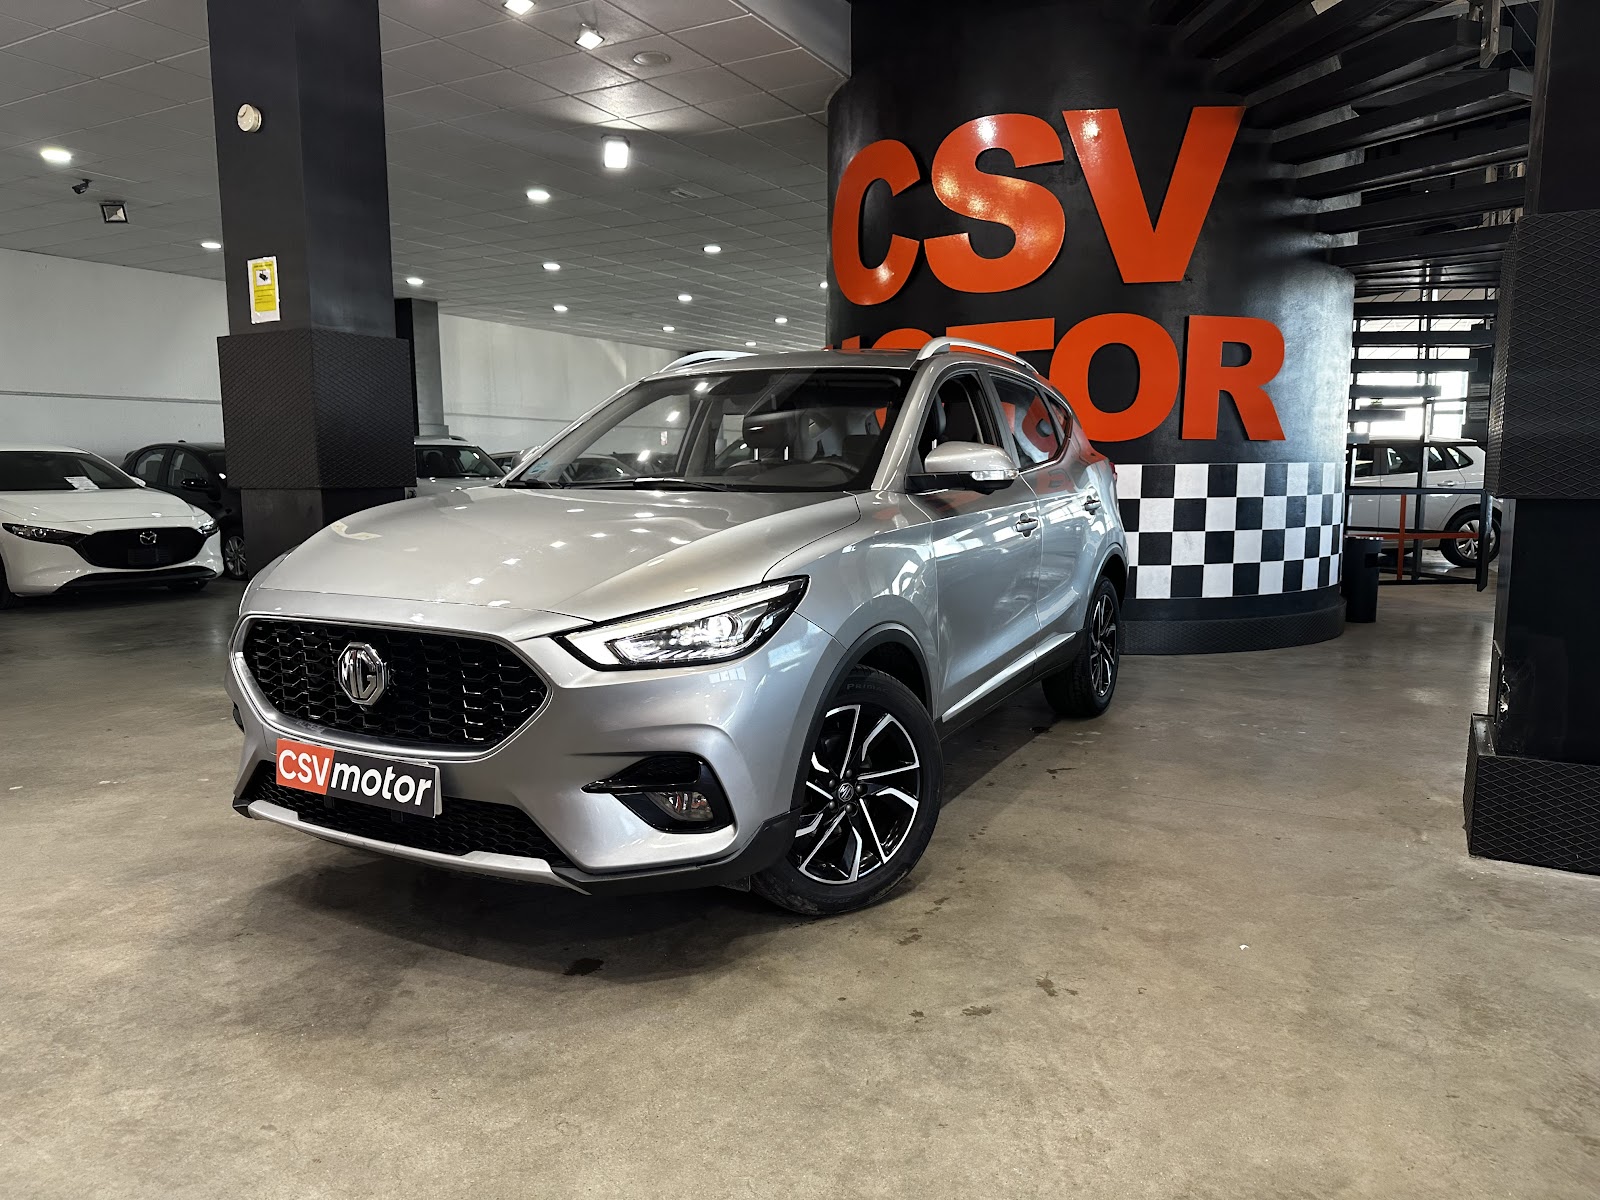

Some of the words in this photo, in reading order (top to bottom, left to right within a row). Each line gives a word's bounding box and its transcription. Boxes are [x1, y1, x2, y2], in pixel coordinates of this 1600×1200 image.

[832, 106, 1247, 306] CSV
[825, 312, 1287, 442] TOR
[340, 645, 383, 703] MG
[278, 749, 433, 806] CSVmotor
